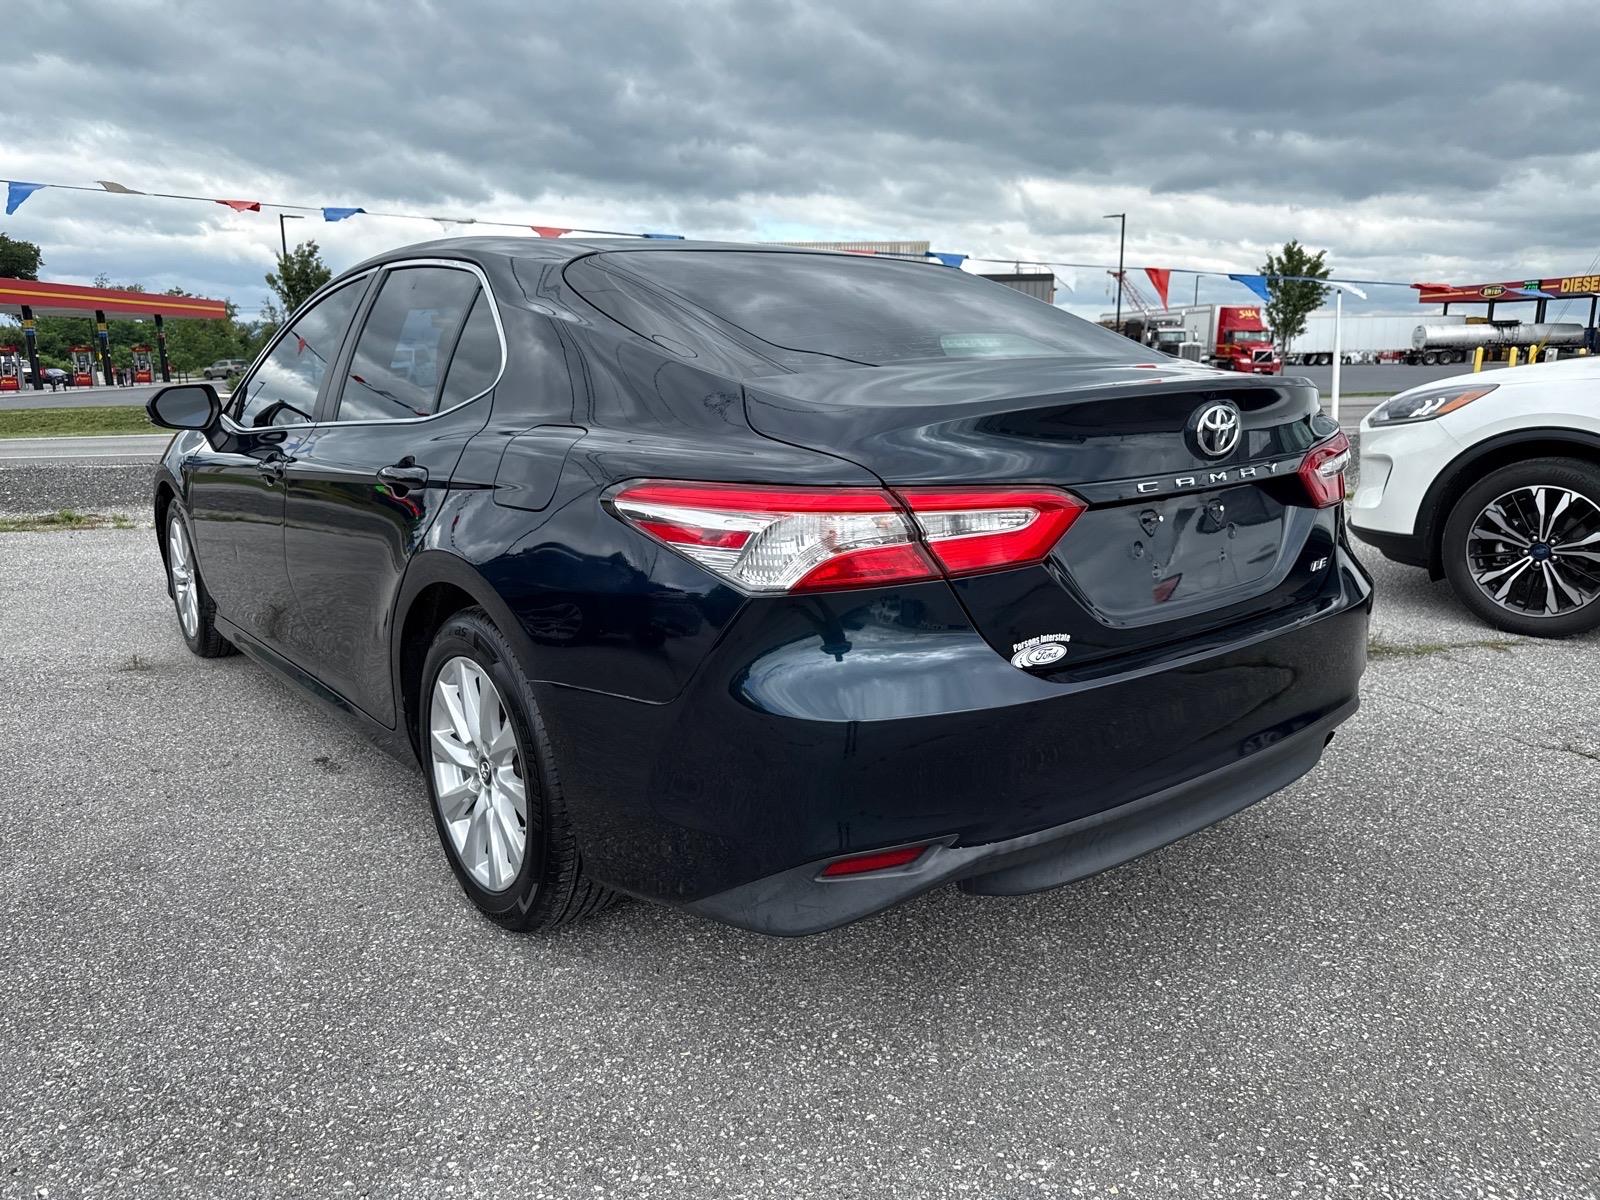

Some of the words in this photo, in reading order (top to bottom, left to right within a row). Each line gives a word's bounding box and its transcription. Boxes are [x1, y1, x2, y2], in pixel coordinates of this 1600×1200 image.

[1561, 276, 1600, 293] DIESE
[1137, 463, 1278, 493] CAMRY
[1012, 636, 1040, 652] Parsons
[1040, 633, 1070, 643] Interstate
[1035, 647, 1059, 661] Ford
